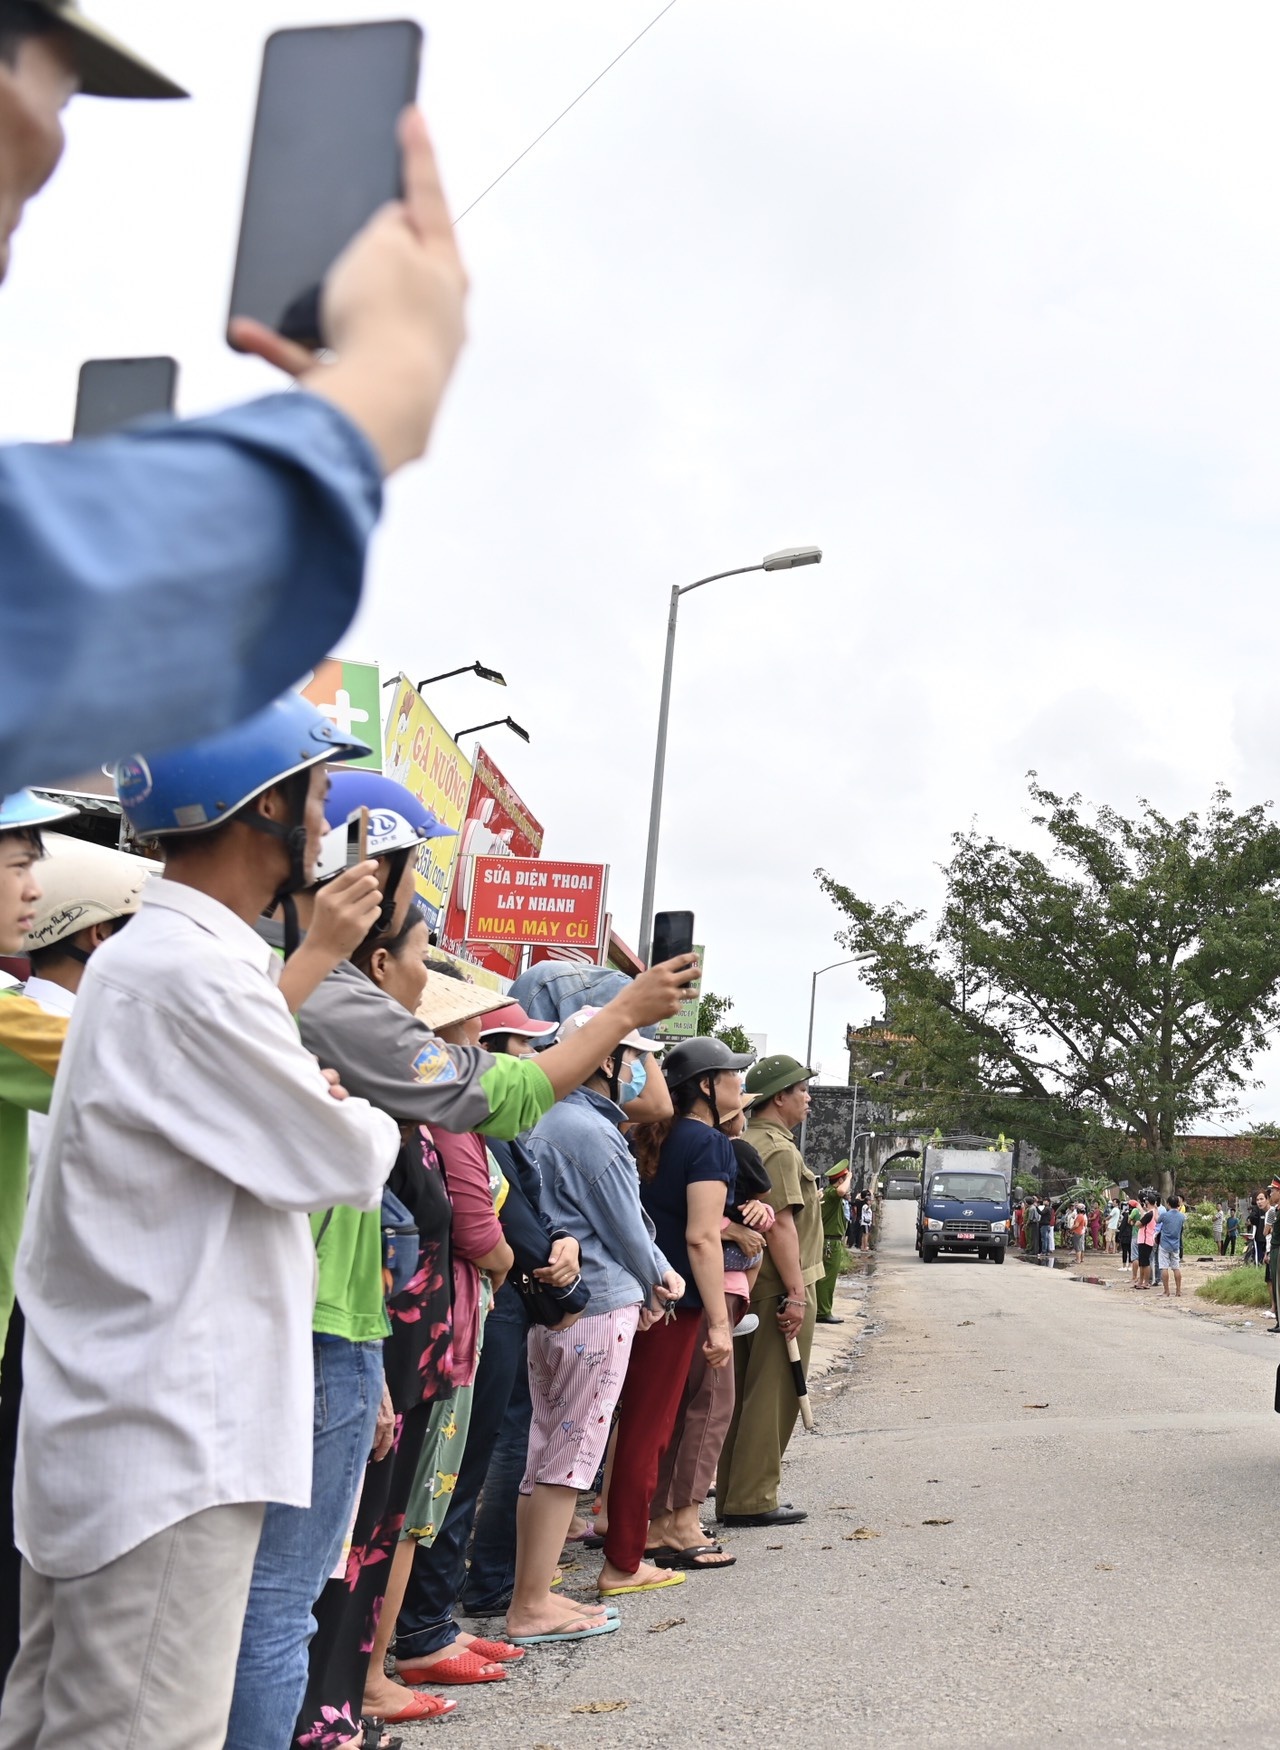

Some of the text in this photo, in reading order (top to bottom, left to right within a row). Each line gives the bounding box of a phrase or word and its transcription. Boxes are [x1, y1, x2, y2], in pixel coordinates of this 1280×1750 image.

[484, 864, 593, 893] SỬA ĐIỆN THOẠI
[497, 890, 575, 913] LẤY NHANH
[478, 917, 589, 938] MUA MÁY CŨ
